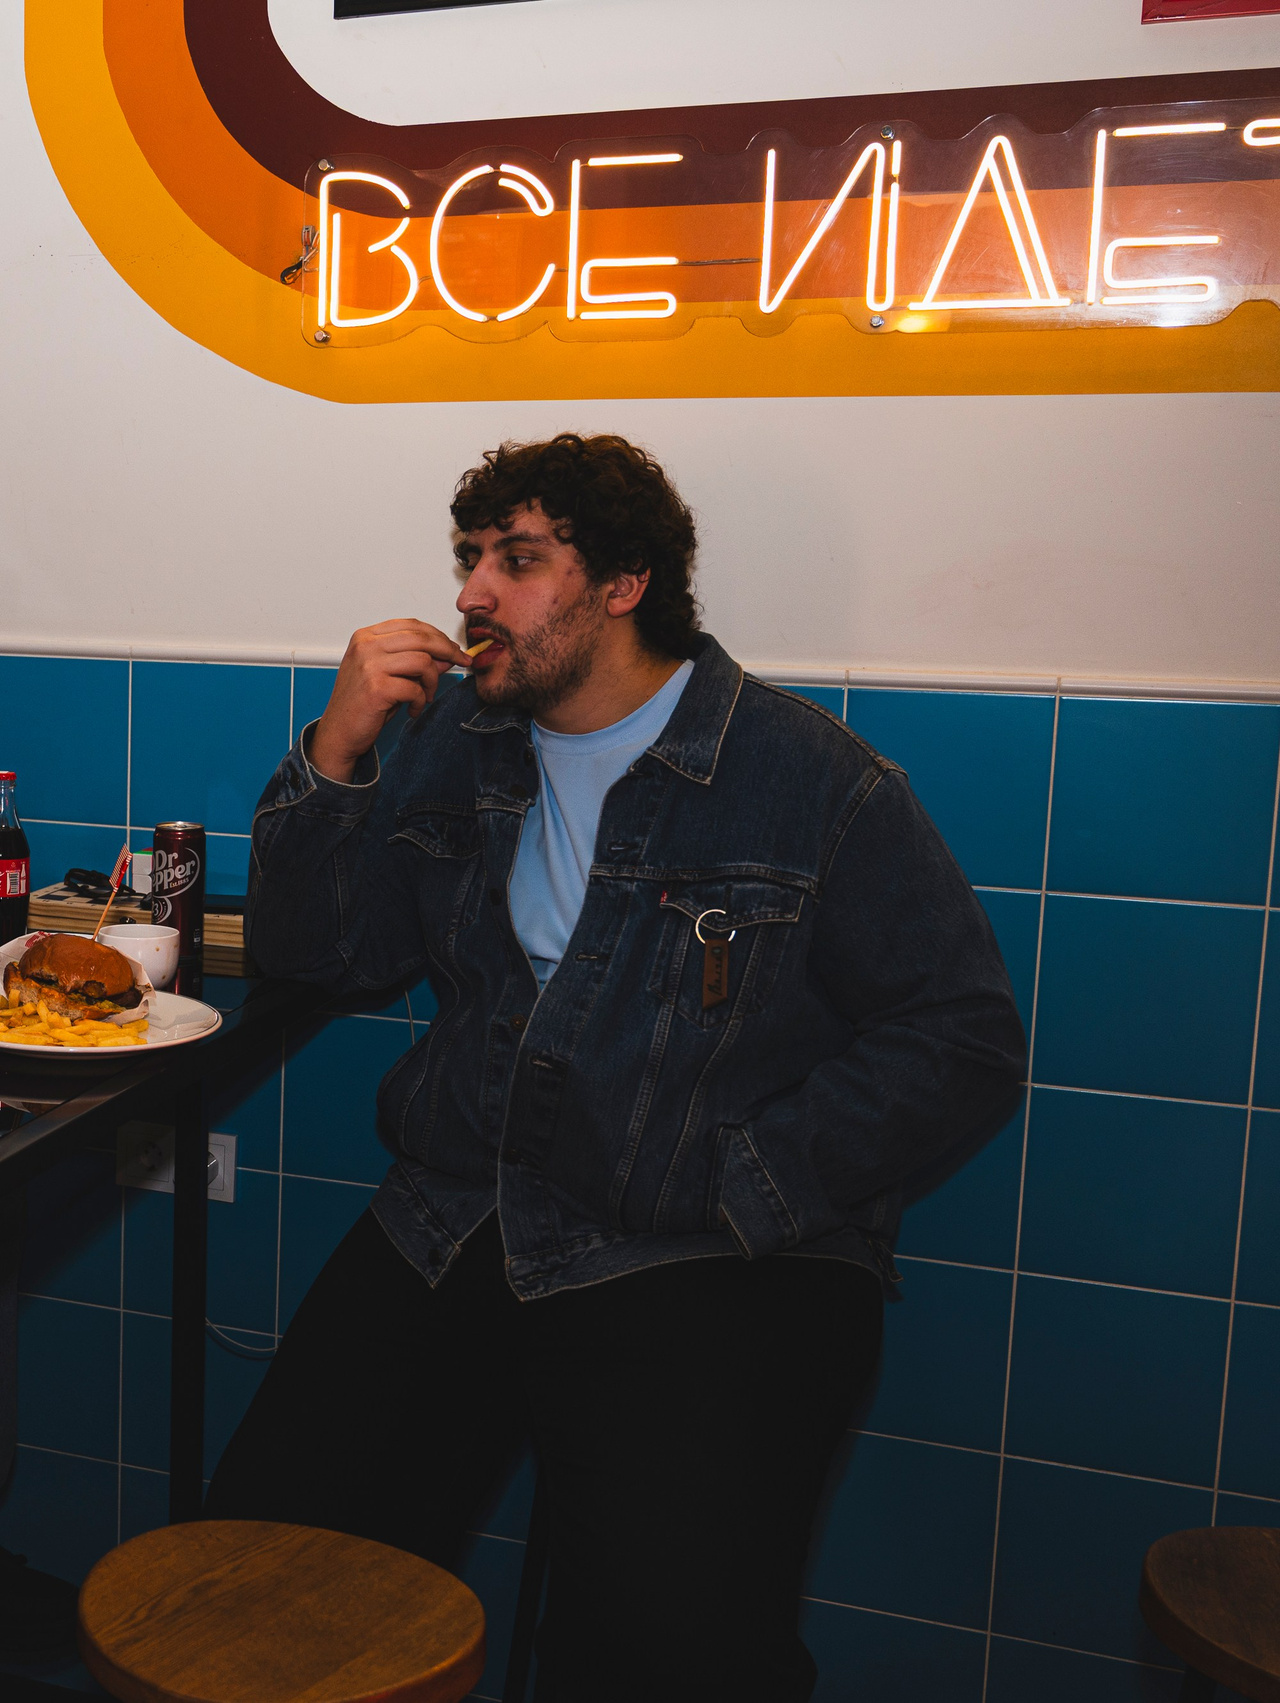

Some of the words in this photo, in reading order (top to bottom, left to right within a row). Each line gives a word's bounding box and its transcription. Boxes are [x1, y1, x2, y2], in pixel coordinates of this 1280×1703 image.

[317, 152, 684, 328] ВСЕ
[756, 116, 1280, 315] ИДЕ
[151, 860, 196, 893] pper
[154, 849, 179, 871] Dr
